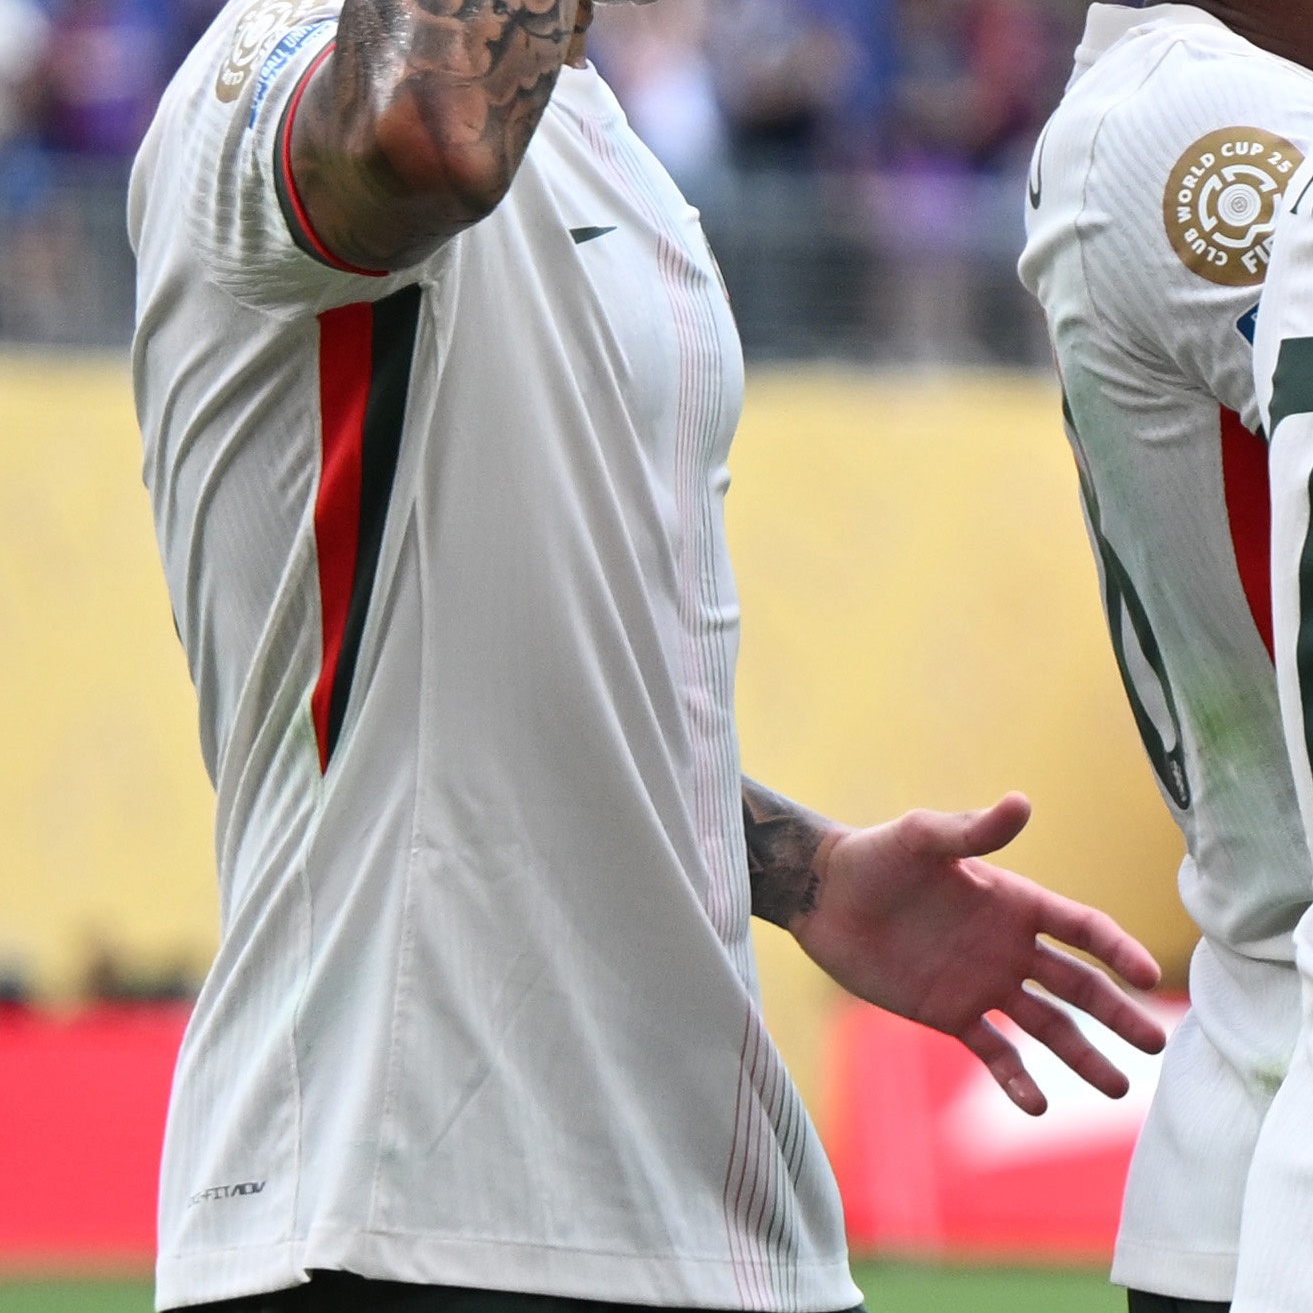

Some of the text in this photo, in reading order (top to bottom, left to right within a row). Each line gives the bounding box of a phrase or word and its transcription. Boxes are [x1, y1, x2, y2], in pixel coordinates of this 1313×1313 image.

[1176, 142, 1293, 274] FI CLUB WORLD CUP 25
